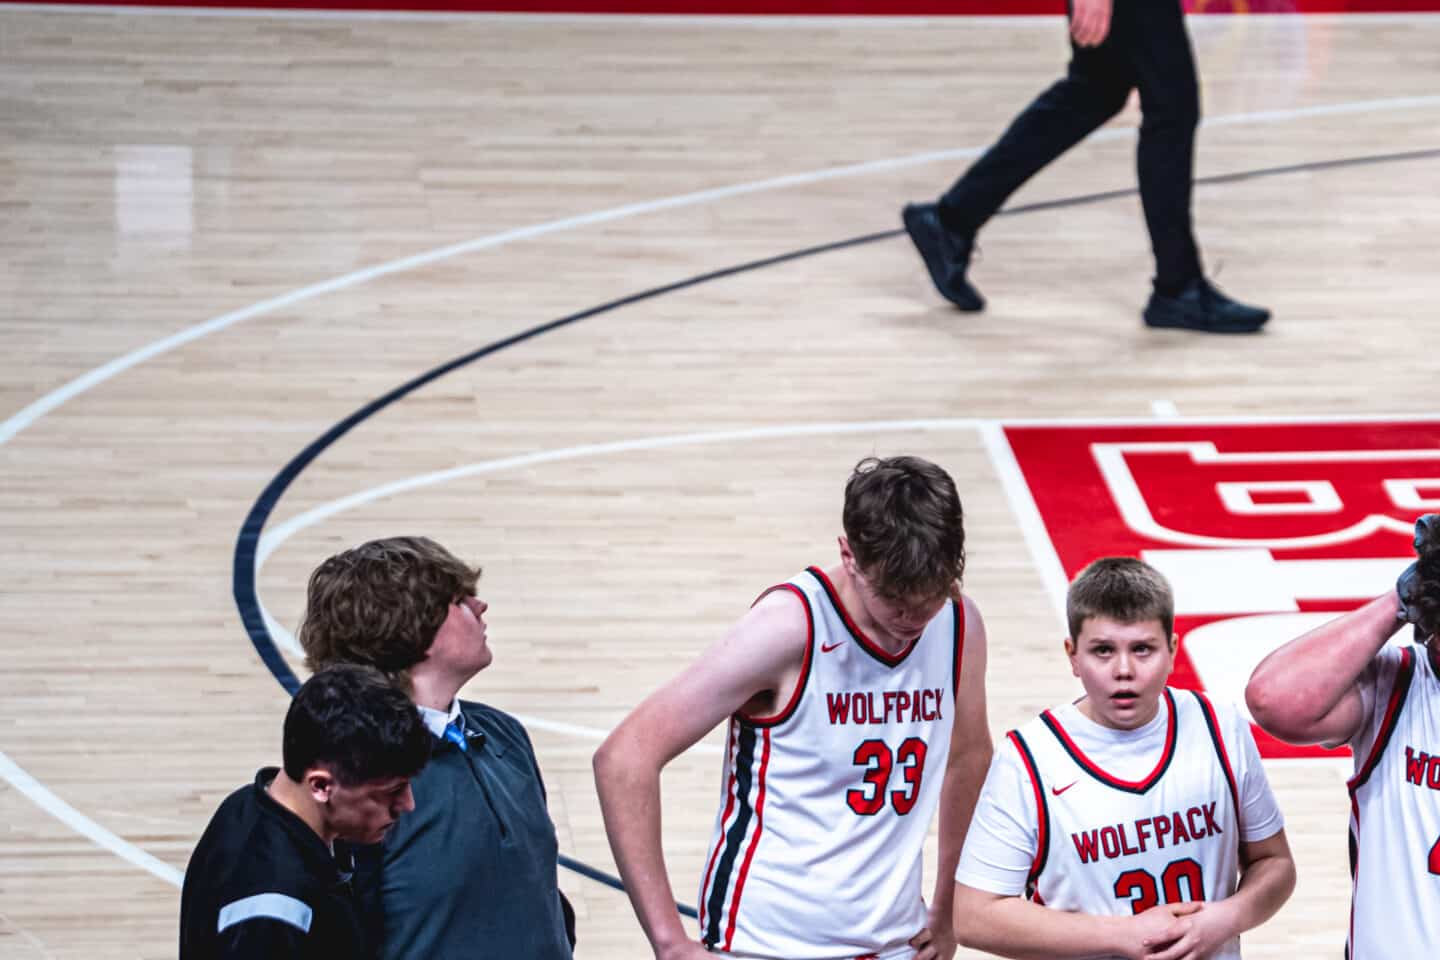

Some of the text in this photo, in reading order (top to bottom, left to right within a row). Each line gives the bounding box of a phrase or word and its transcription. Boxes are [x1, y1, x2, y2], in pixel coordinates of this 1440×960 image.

[826, 686, 945, 725] WOLFPACK
[846, 736, 929, 816] 33
[1072, 801, 1224, 864] WOLFPACK
